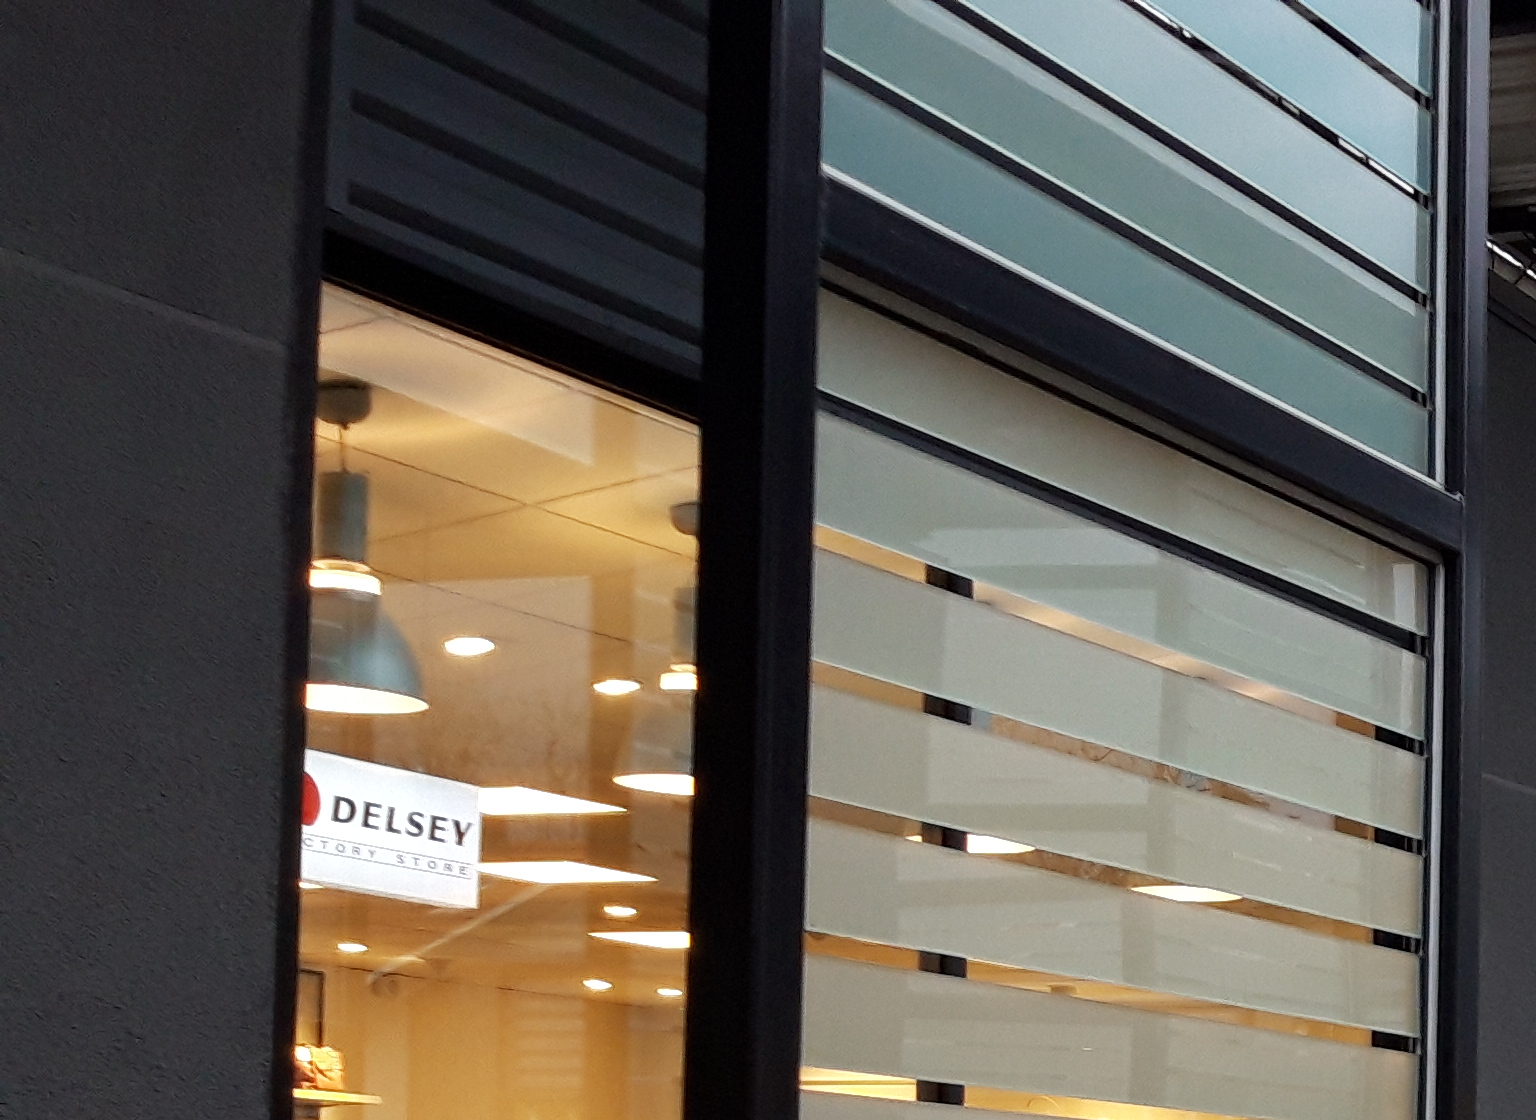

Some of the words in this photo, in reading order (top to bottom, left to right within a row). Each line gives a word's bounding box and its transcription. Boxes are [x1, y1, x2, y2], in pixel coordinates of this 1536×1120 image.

[330, 795, 474, 848] DELSEY
[302, 837, 376, 859] CTORY
[396, 854, 471, 877] STORE
